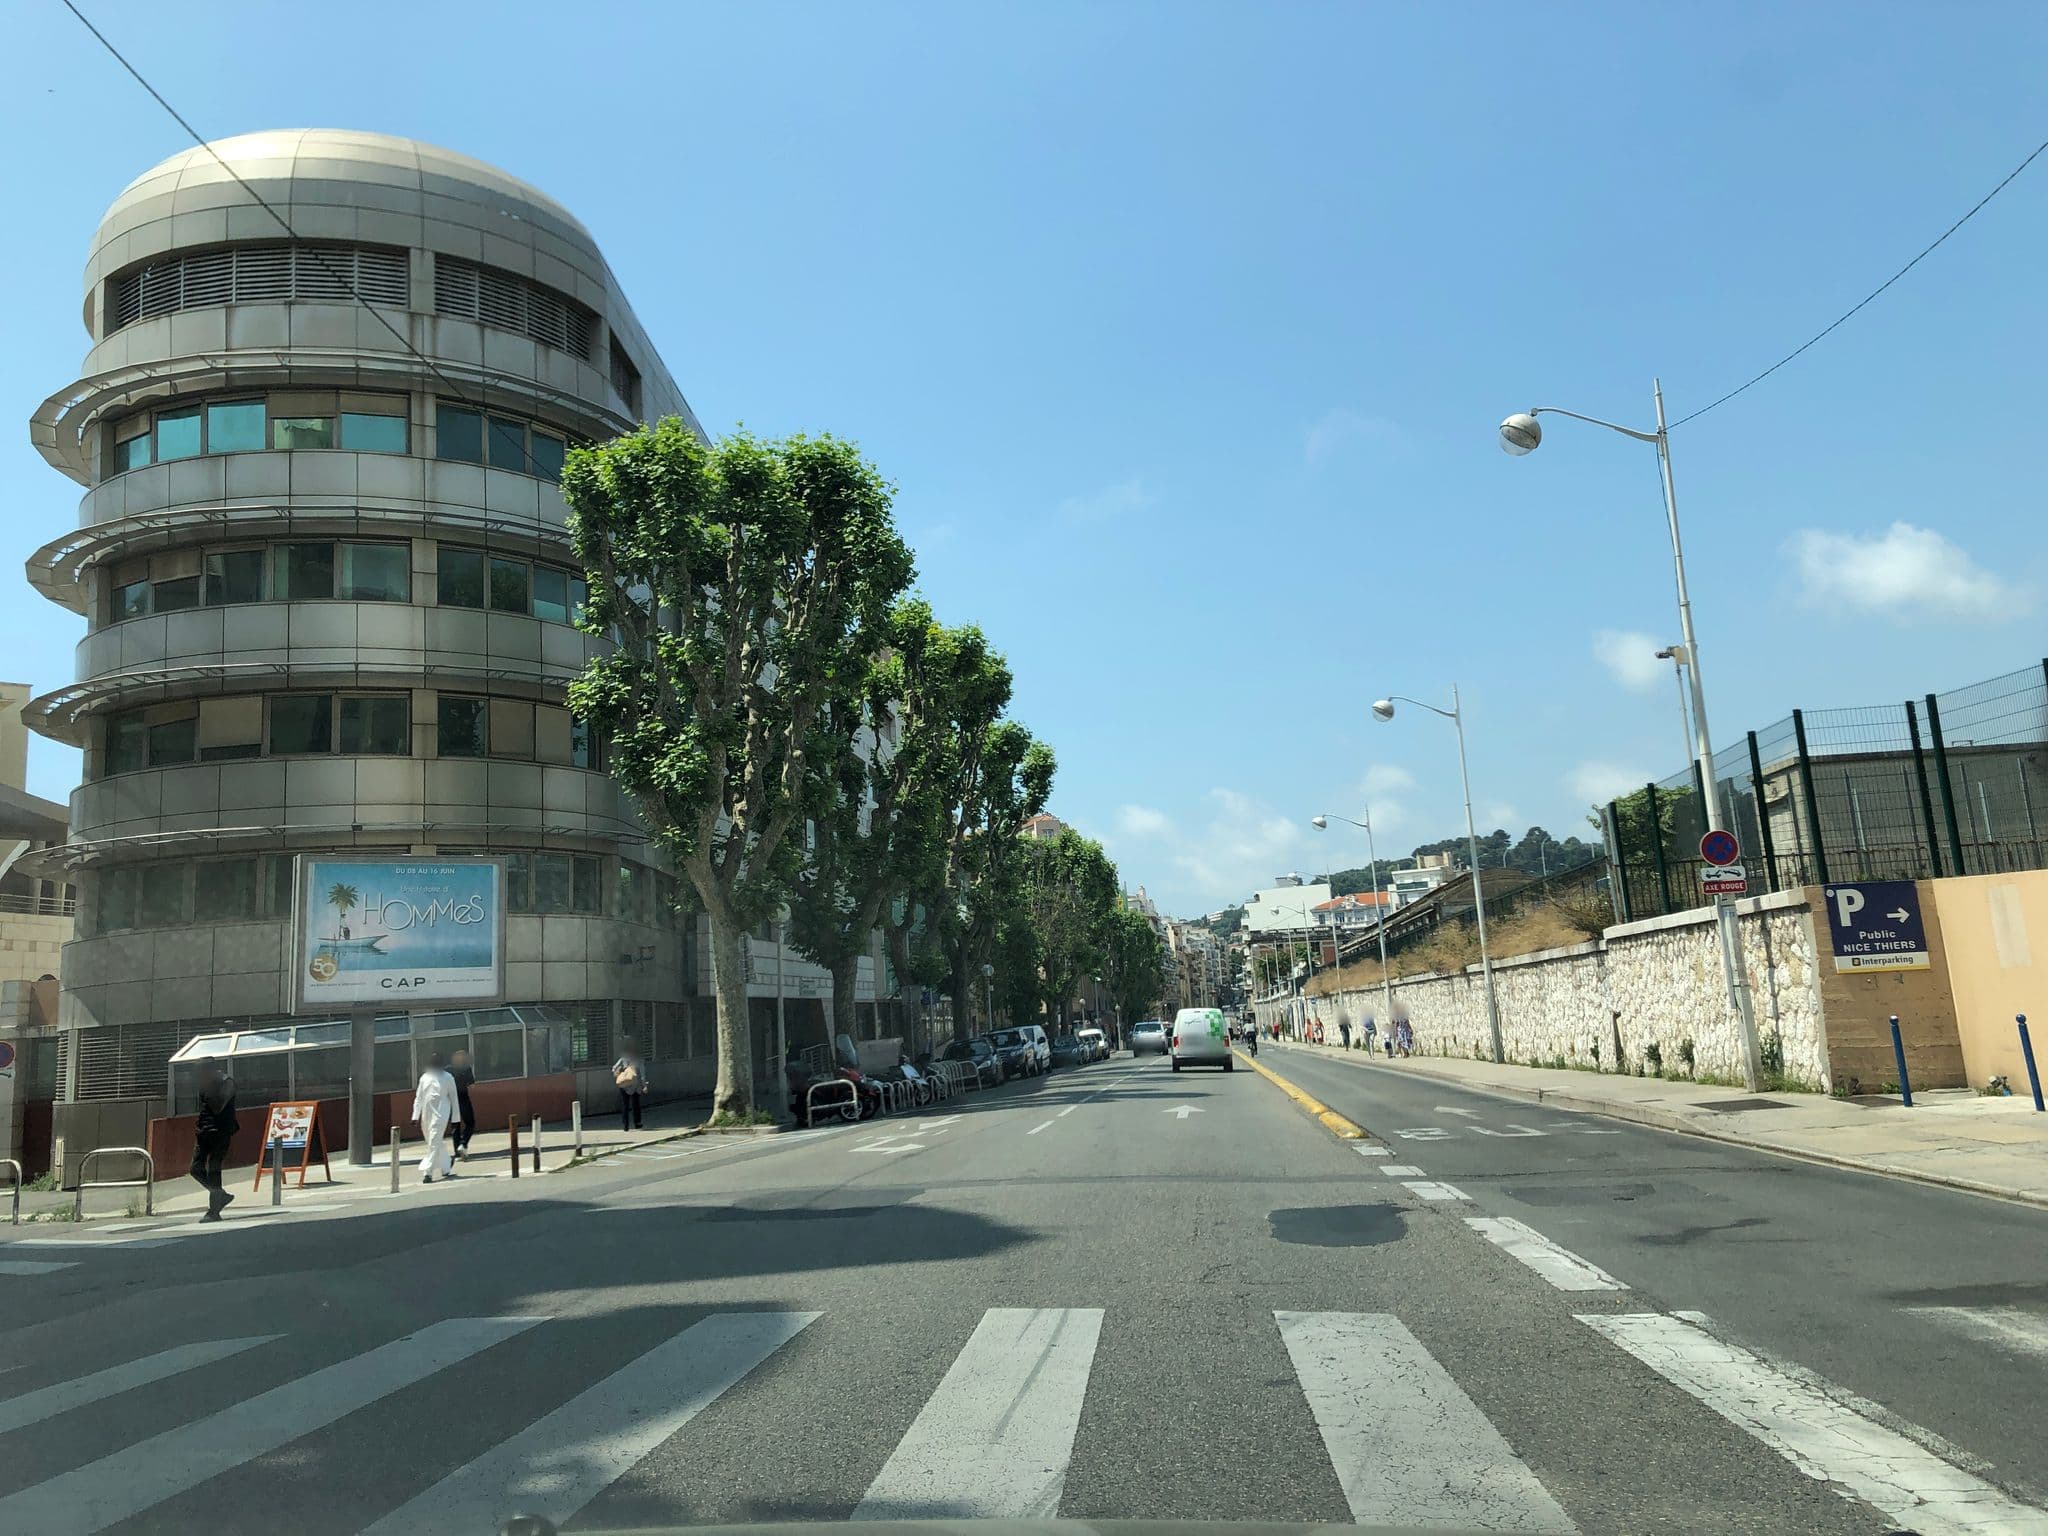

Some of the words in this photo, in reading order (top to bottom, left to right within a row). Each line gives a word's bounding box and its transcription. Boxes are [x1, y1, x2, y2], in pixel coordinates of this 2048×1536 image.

[1720, 882, 1744, 890] ROUGE
[1835, 888, 1865, 927] P
[1859, 930, 1896, 940] Public
[1843, 943, 1872, 952] NICE
[1874, 940, 1916, 951] THIERS
